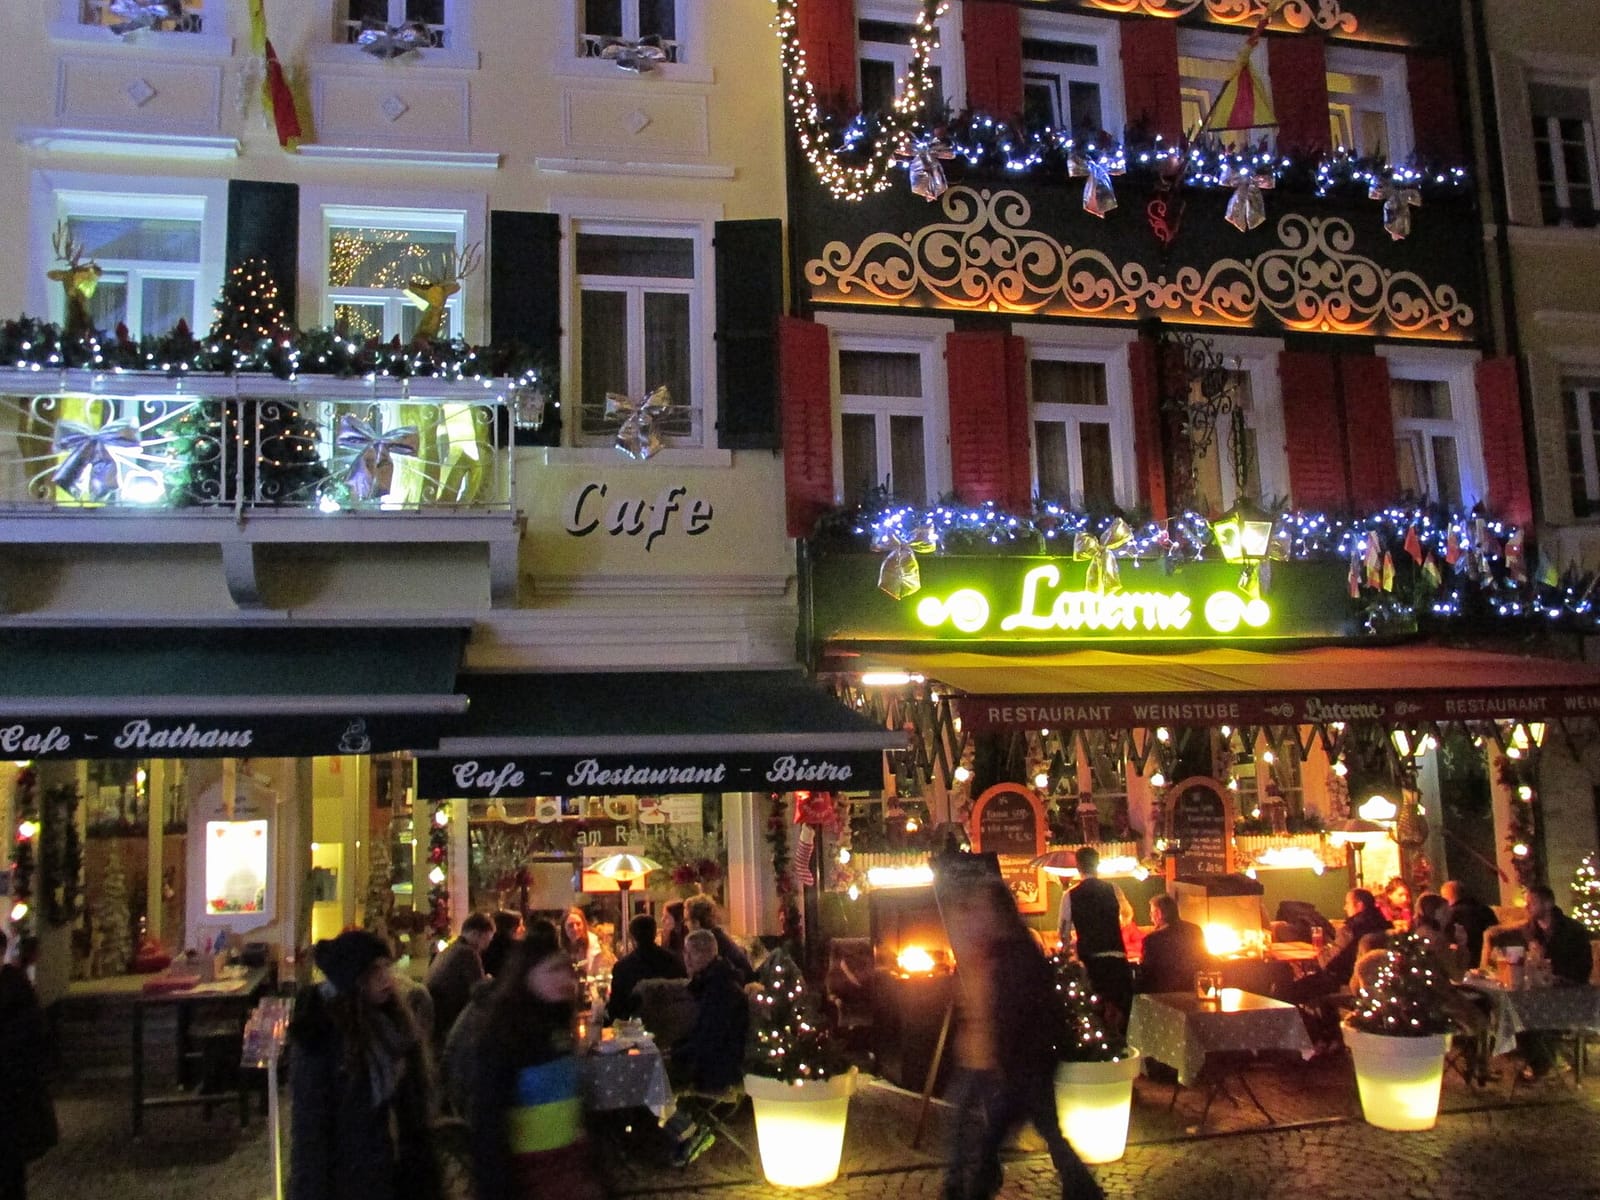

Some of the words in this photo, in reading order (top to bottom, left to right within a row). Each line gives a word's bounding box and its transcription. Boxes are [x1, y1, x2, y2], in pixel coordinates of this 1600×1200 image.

[564, 484, 713, 552] Cafe
[1001, 564, 1192, 632] Laterne
[988, 705, 1113, 724] RESTAURANT
[1133, 702, 1241, 721] WEINSTUBE
[1445, 697, 1546, 715] RESTAURANT
[0, 725, 71, 757] Cafe
[114, 718, 253, 748] Rathaus
[452, 759, 525, 797] Cafe
[566, 757, 726, 788] Restaurant
[765, 755, 853, 783] Bistro
